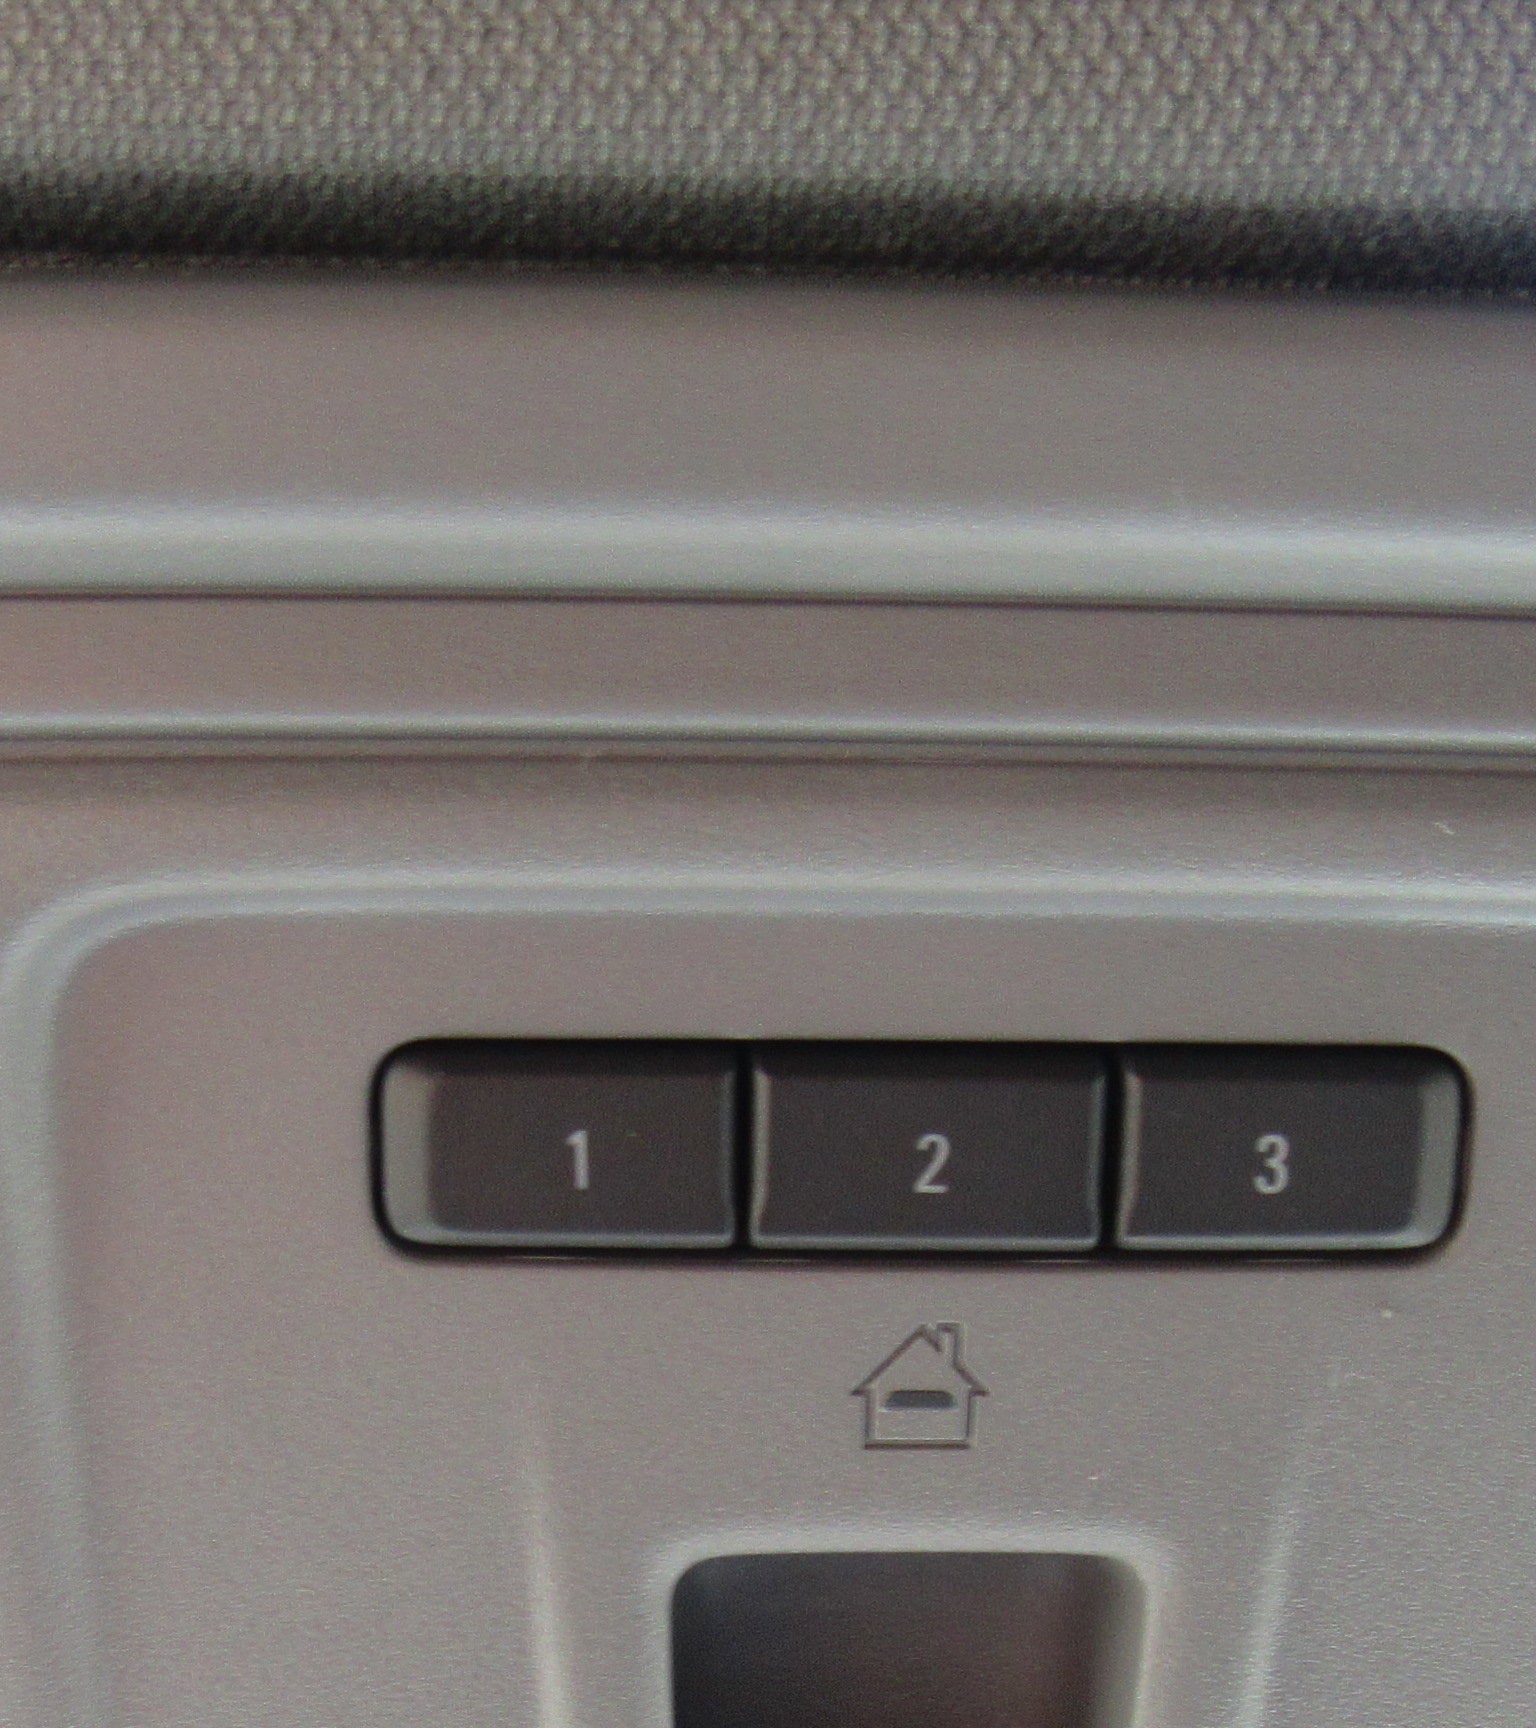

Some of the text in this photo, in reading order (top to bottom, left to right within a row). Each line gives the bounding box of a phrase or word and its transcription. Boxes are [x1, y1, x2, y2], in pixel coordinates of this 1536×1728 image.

[566, 1128, 590, 1190] 1
[913, 1133, 950, 1193] 2
[1254, 1134, 1290, 1194] 3
